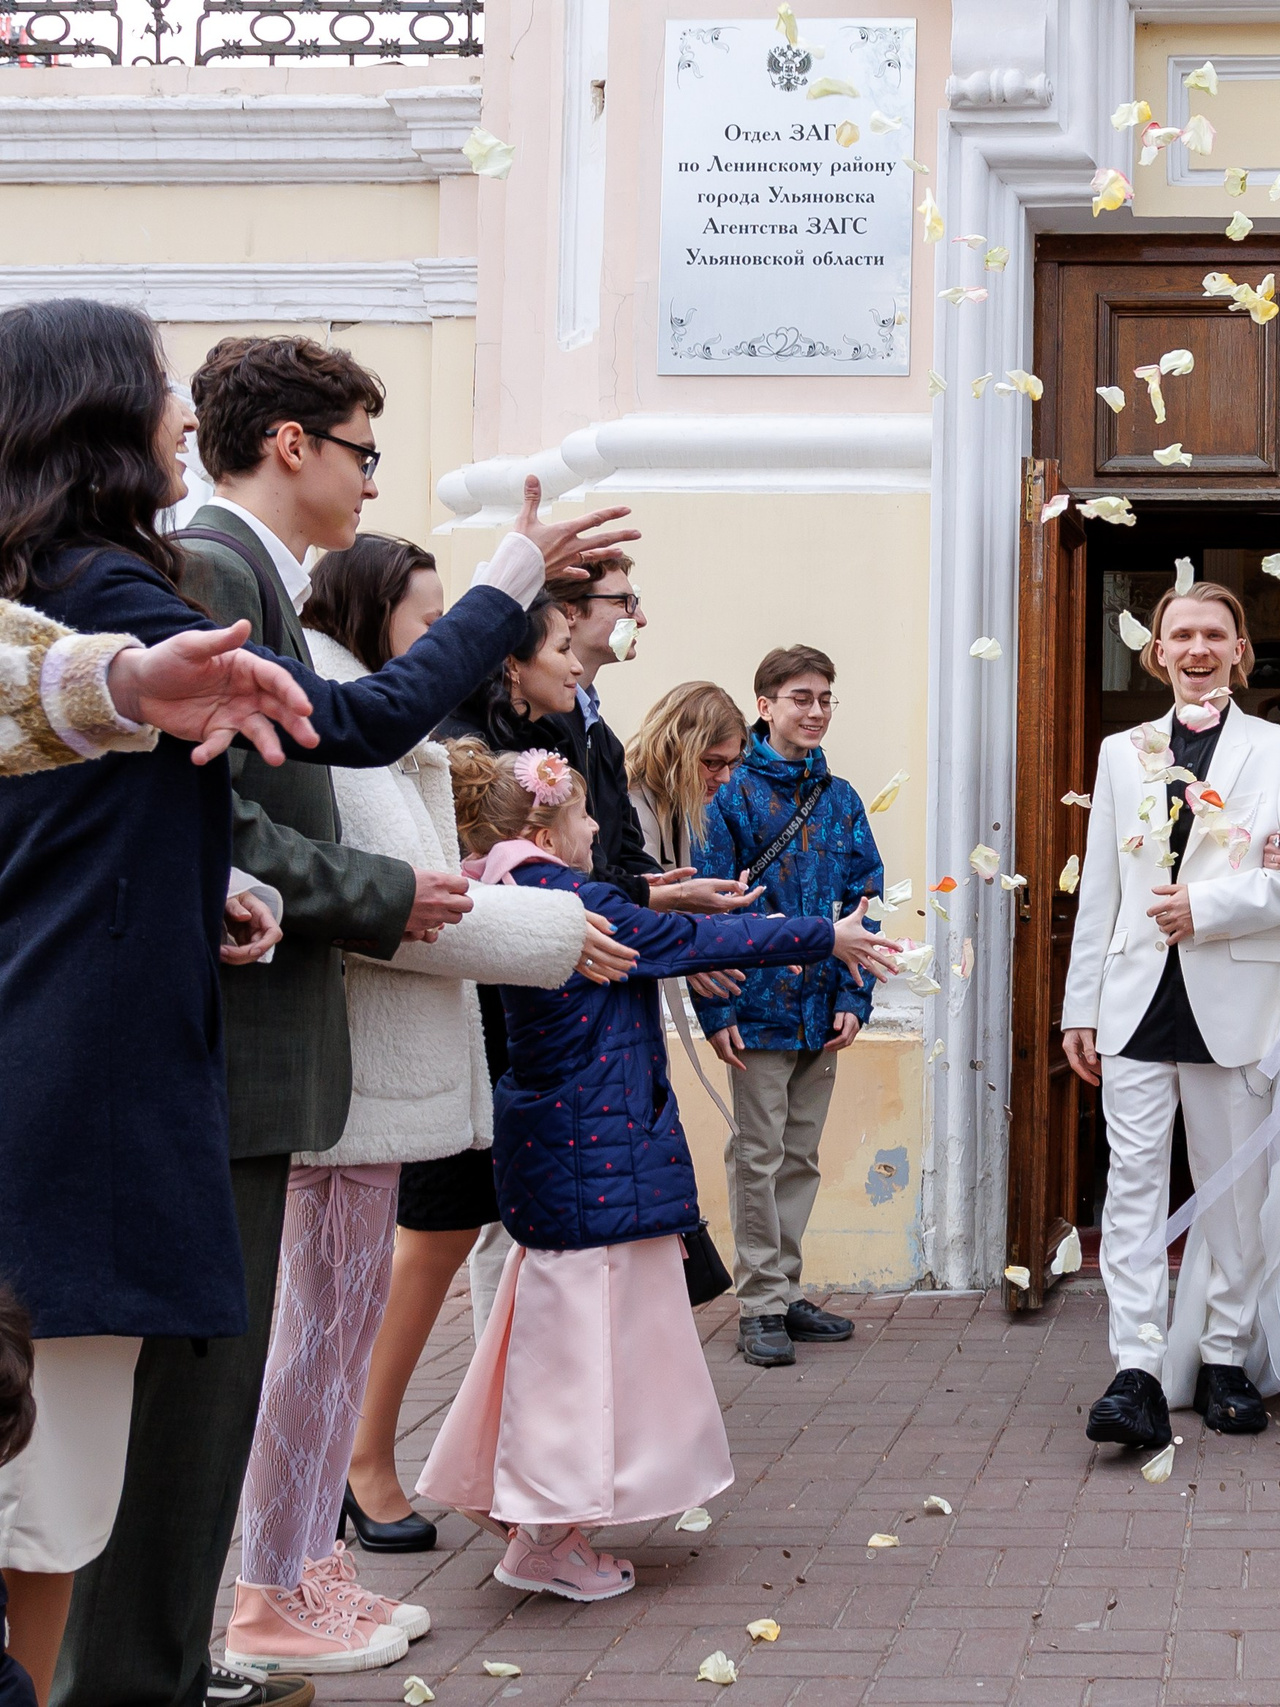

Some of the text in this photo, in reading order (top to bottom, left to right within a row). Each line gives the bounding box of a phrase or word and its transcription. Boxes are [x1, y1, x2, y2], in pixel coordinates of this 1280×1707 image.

[724, 123, 839, 144] Отдел ЗАГ
[678, 155, 897, 177] по Ленинскому району
[697, 186, 875, 208] города Ульяновска
[702, 216, 868, 235] Агентства ЗАГС
[686, 248, 885, 266] Ульяновской области
